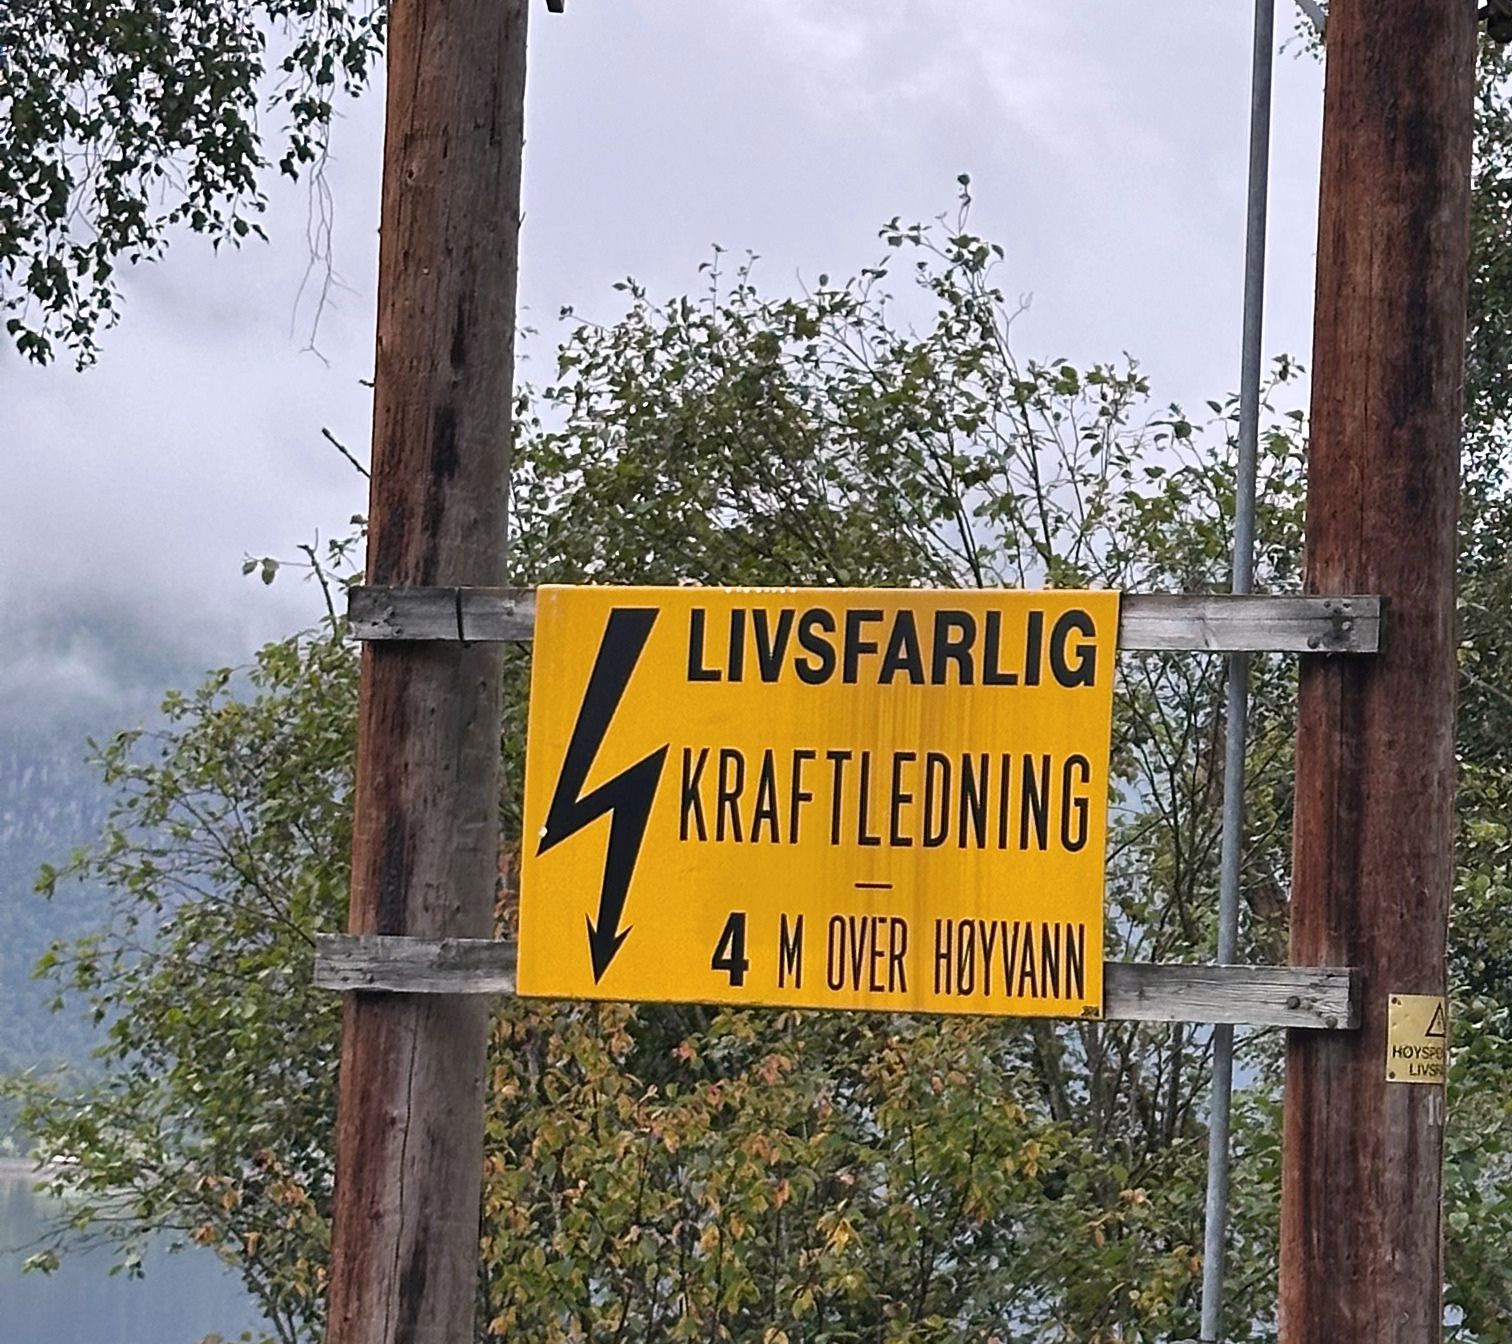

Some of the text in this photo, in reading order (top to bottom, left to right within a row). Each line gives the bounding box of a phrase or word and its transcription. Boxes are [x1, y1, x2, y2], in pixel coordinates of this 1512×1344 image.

[687, 608, 1097, 688] LIVSFARLIG
[679, 748, 1090, 853] KRAFTLEDNING
[711, 912, 1085, 1000] 4 M OVER HØYVANN
